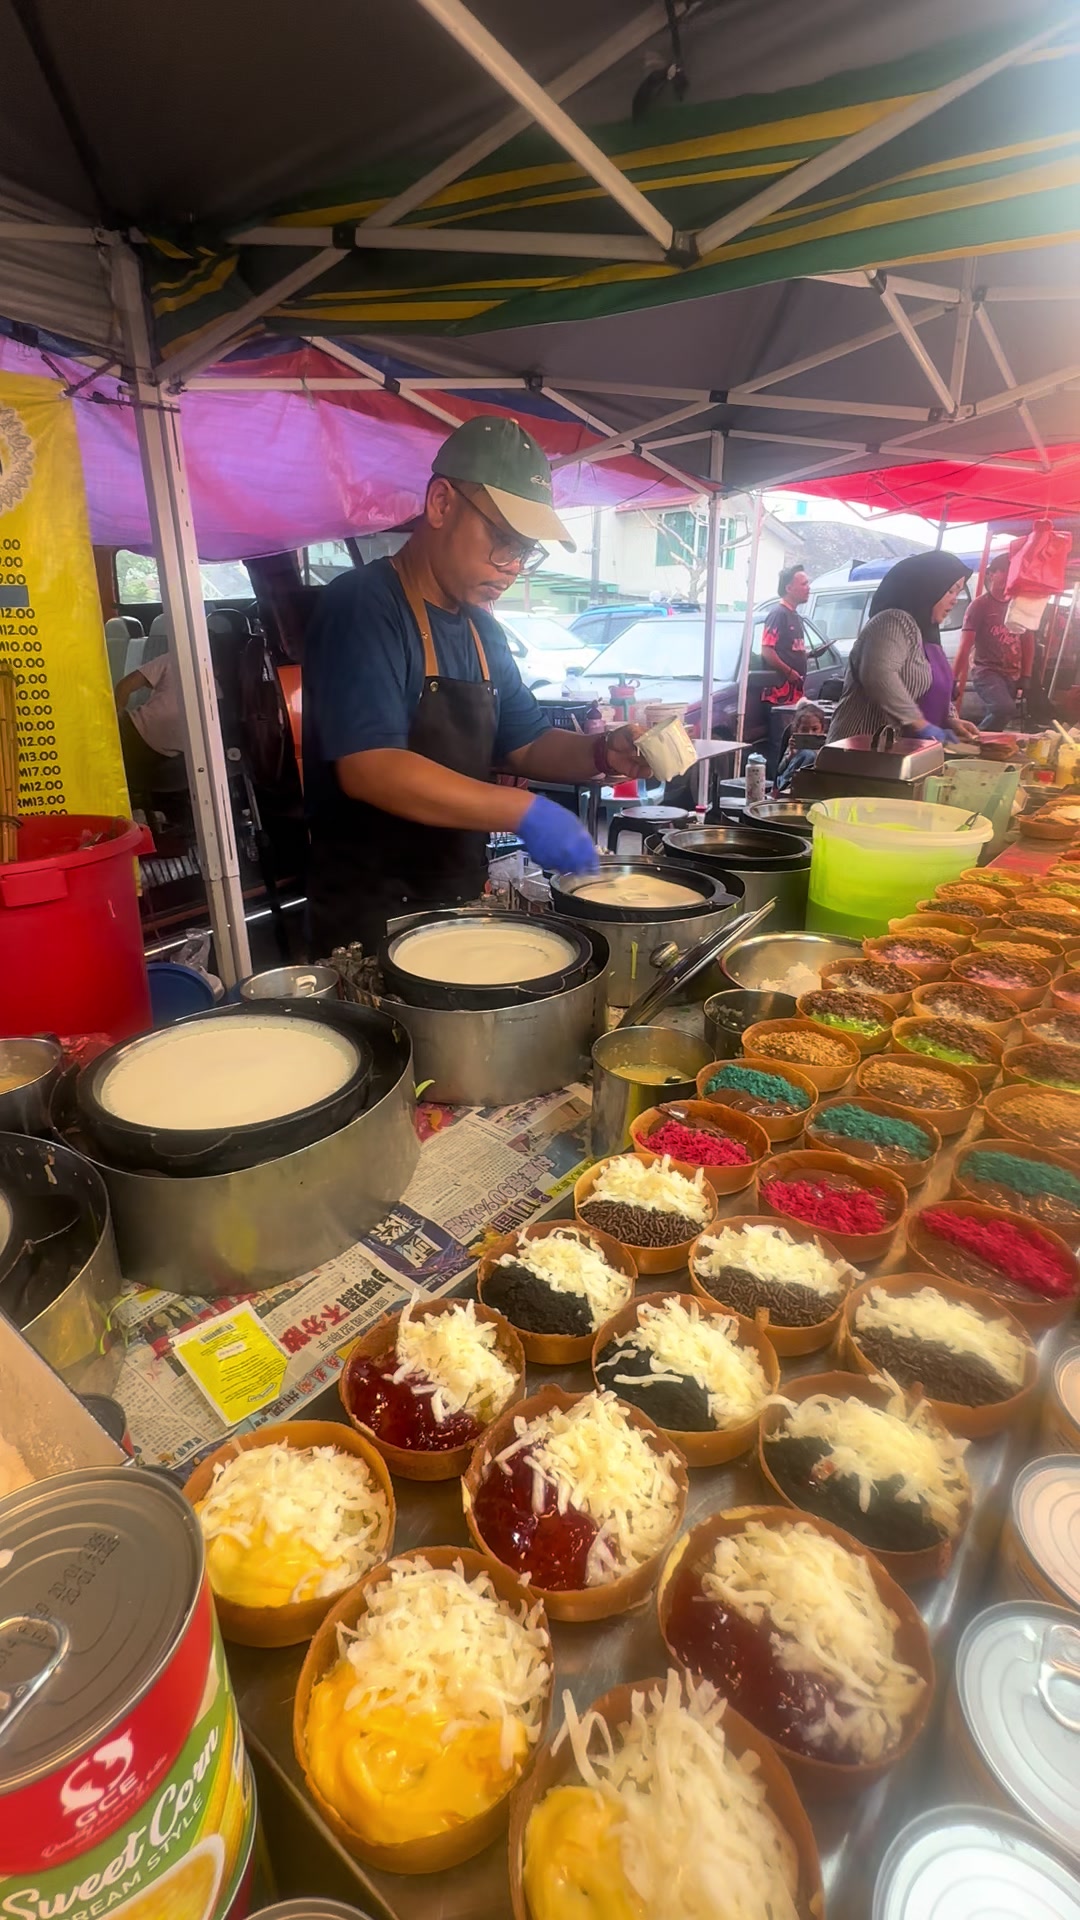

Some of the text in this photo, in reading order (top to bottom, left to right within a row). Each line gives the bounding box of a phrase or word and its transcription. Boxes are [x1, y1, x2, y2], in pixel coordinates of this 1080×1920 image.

[0, 556, 23, 568] .00
[16, 720, 55, 732] 10.00
[369, 1213, 443, 1269] 國際
[2, 1825, 147, 1920] Sweet
[149, 1725, 219, 1847] Corn
[75, 1770, 139, 1828] GCE
[66, 1870, 141, 1920] REAM
[147, 1791, 203, 1868] STYLE
